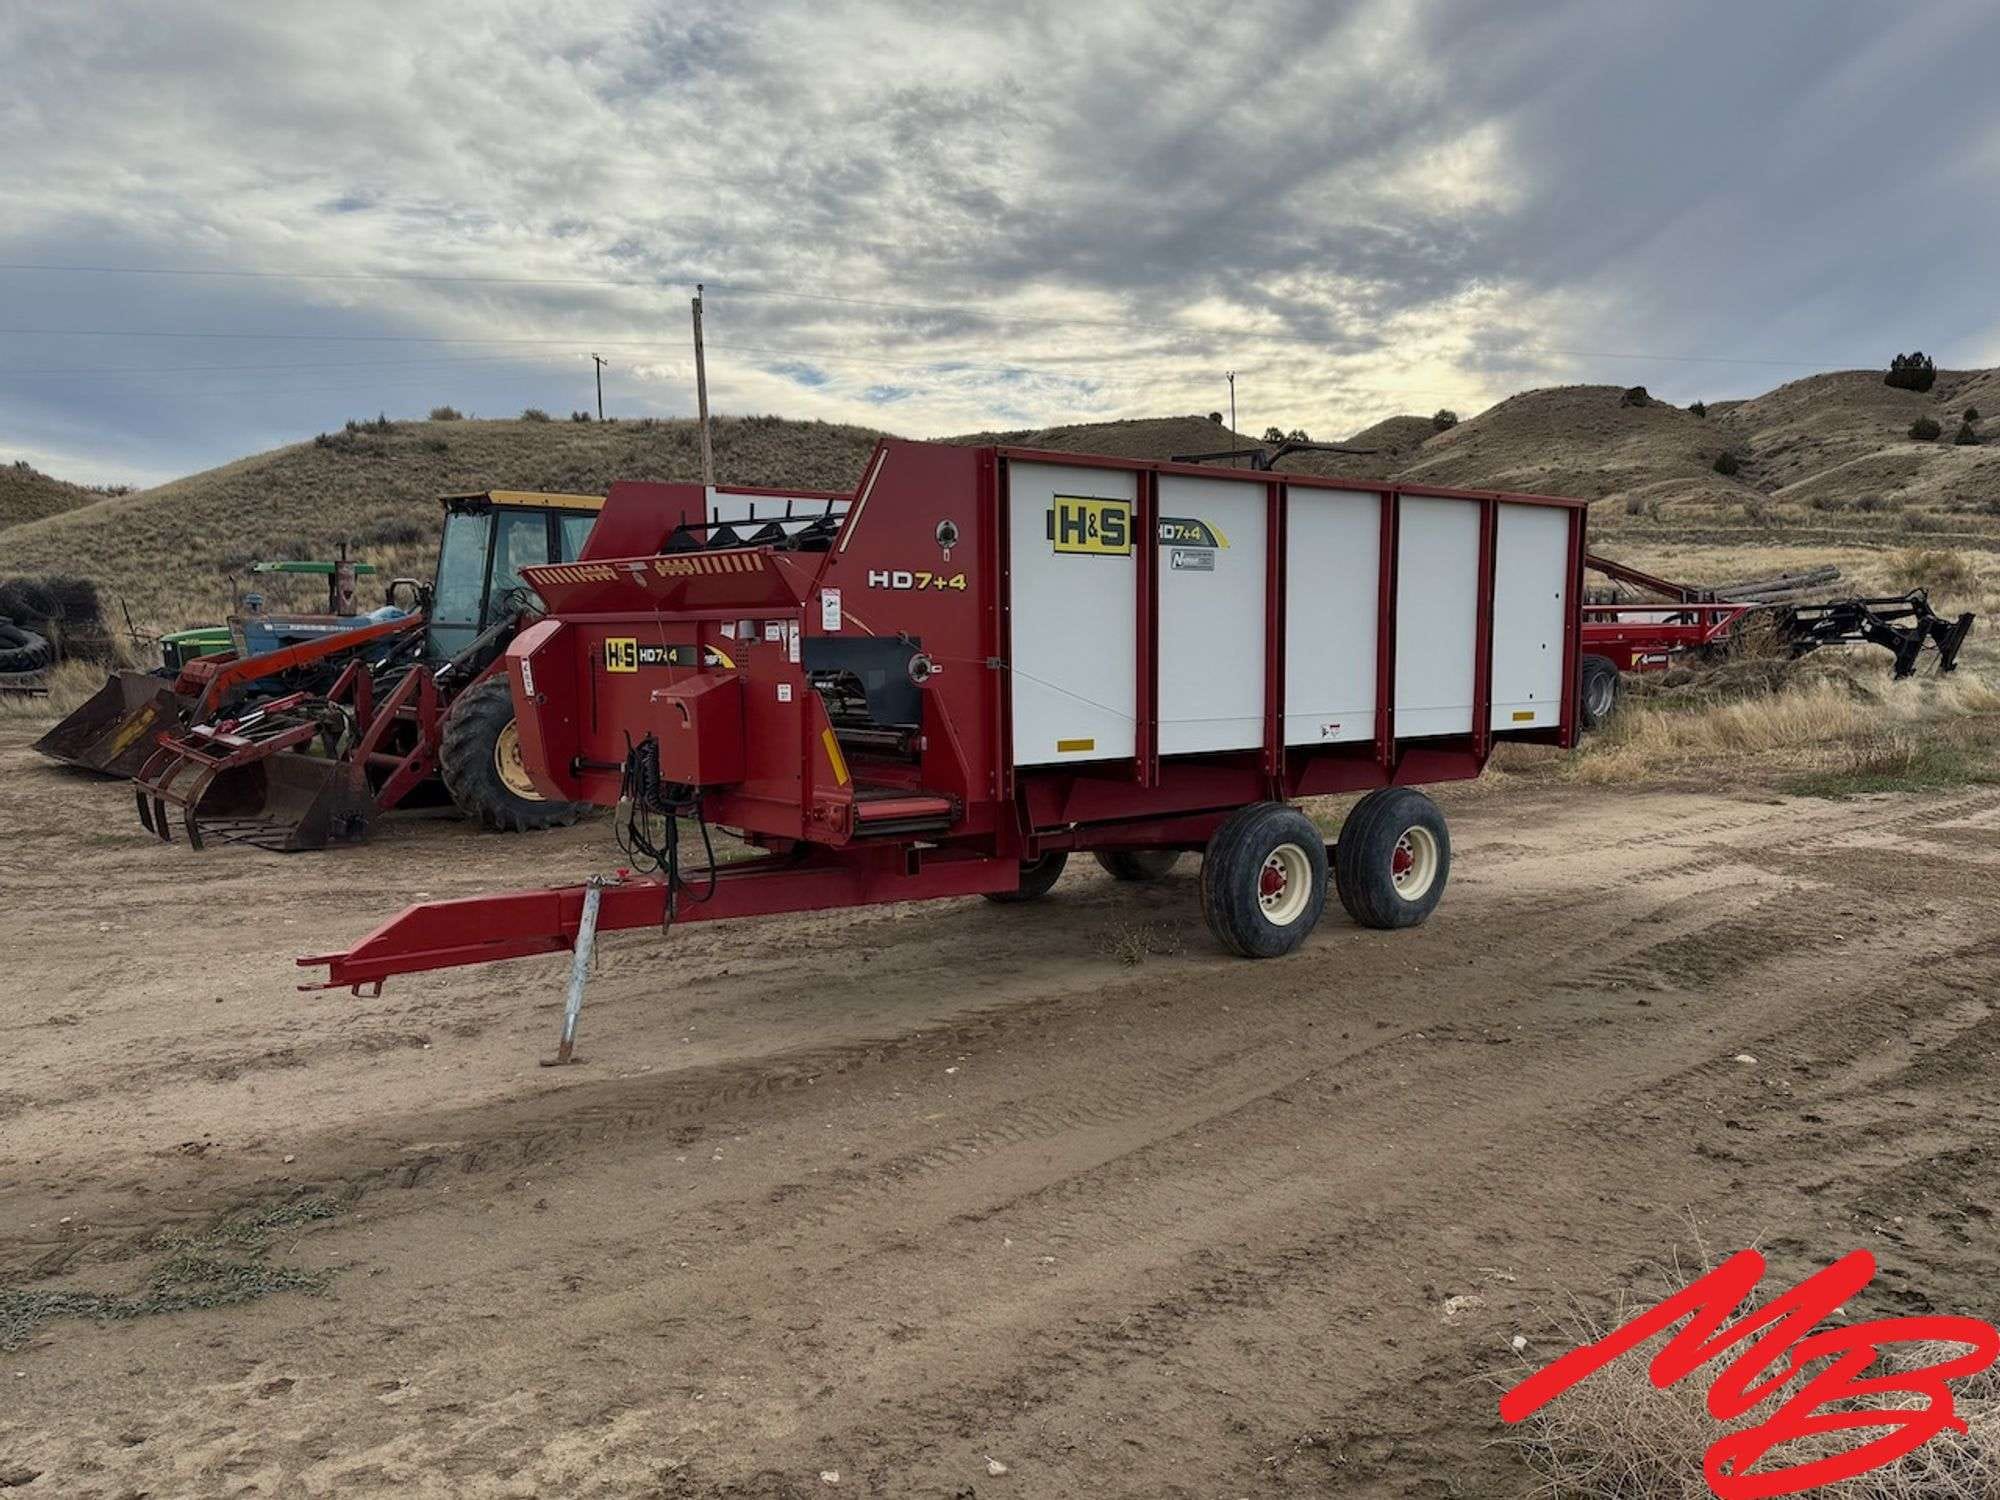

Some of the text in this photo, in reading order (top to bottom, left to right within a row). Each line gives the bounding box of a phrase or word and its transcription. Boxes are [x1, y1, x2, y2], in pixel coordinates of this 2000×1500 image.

[1060, 505, 1125, 546] H&S
[868, 570, 967, 590] HD7+4
[608, 642, 635, 667] H&S
